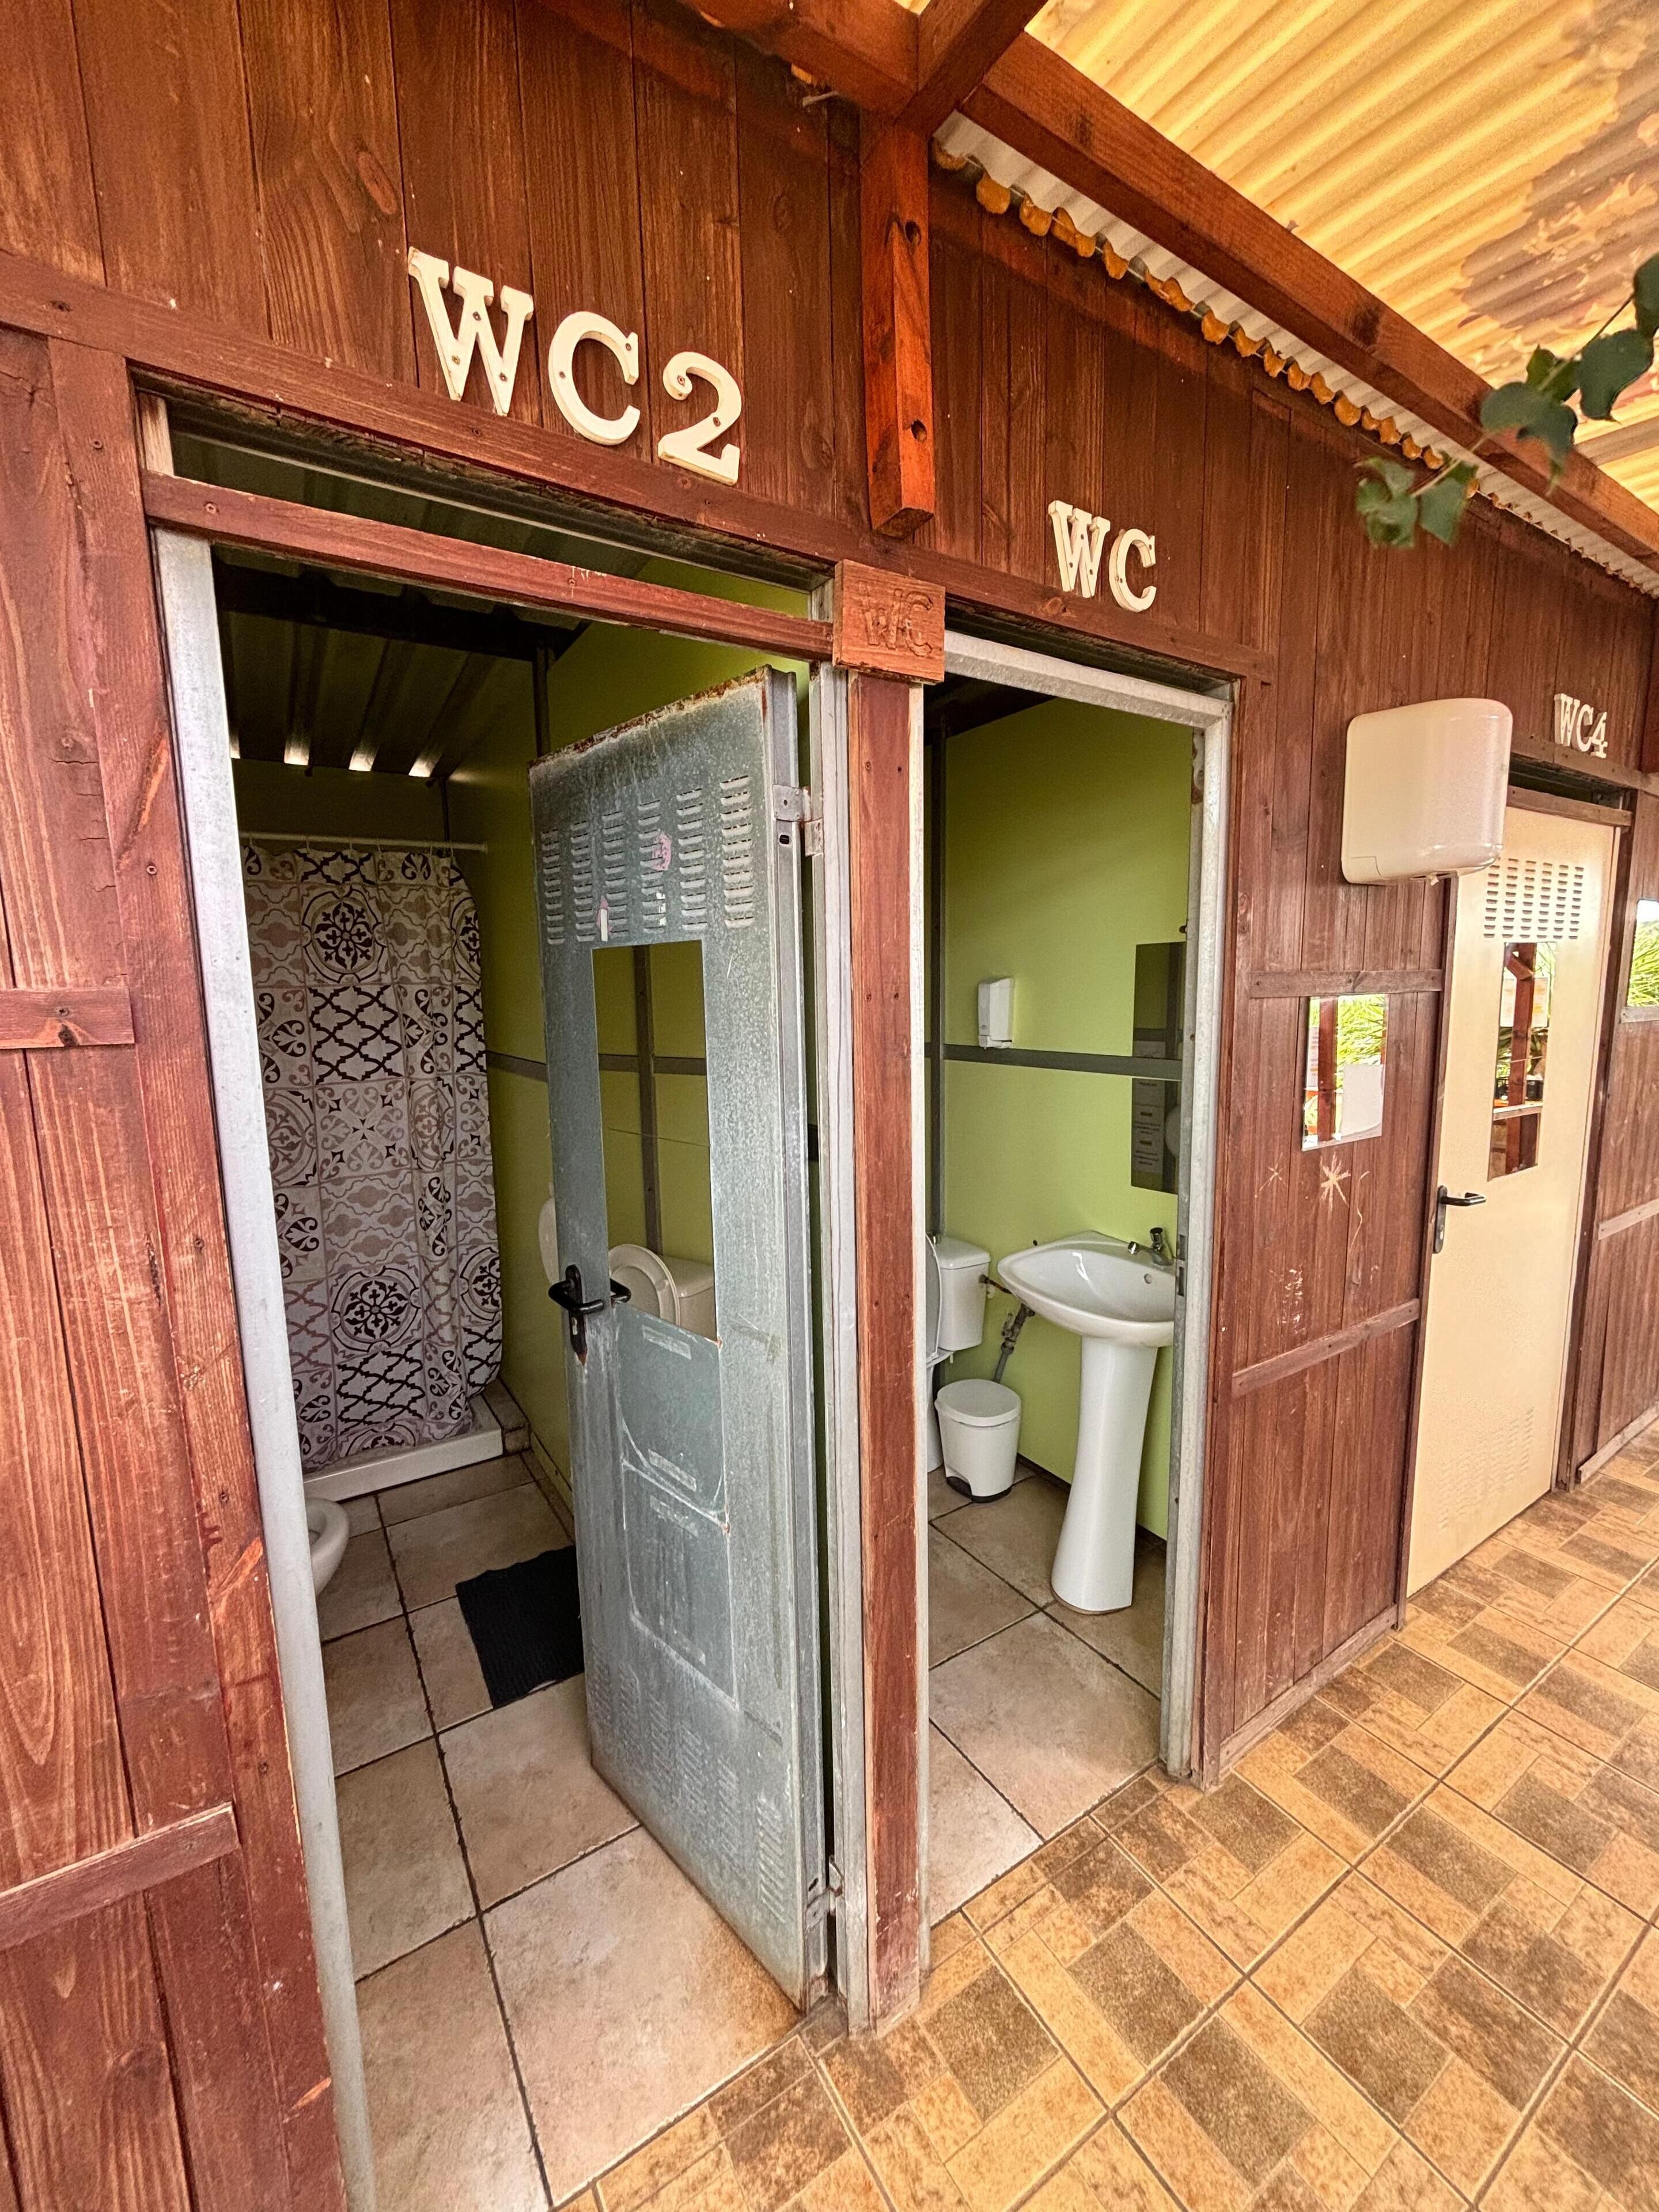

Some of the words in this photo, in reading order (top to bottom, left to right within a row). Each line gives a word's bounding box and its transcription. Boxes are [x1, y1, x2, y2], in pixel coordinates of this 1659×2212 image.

[408, 246, 743, 486] WC2
[1048, 500, 1157, 612] WC
[858, 581, 934, 657] WC
[1554, 693, 1608, 759] WC4
